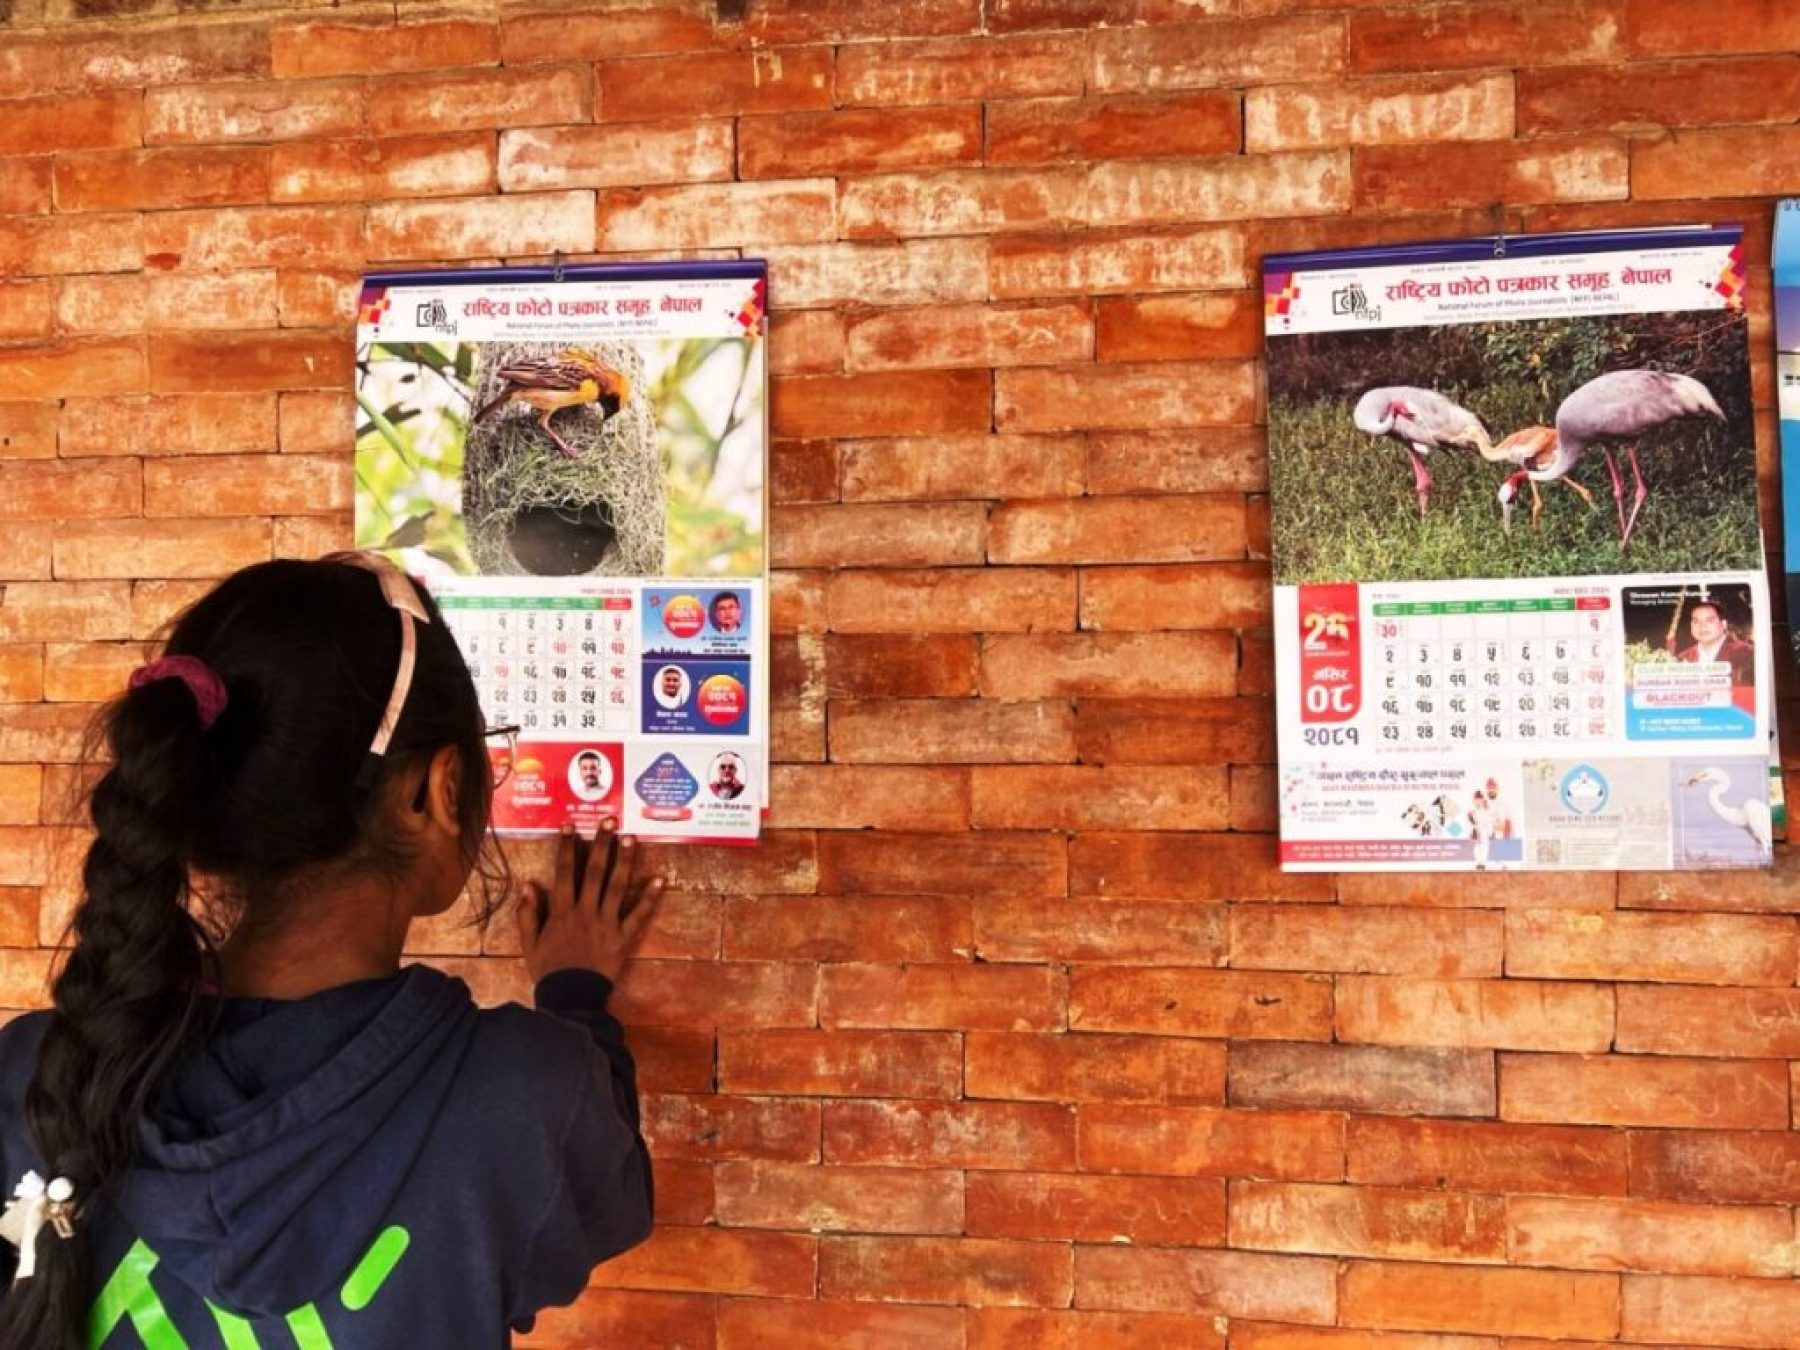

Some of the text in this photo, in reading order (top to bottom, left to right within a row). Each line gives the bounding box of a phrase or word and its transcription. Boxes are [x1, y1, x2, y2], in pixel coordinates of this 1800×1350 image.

[1448, 276, 1490, 296] फोटो
[1497, 276, 1559, 293] पत्रकार
[1621, 267, 1672, 285] नेपाल
[516, 297, 552, 315] फोटो
[558, 300, 608, 316] पत्रकार
[660, 294, 703, 312] नेपाल
[1306, 684, 1355, 712] ०८
[1646, 692, 1712, 703] BLACKOUT
[1304, 728, 1359, 746] २०८१
